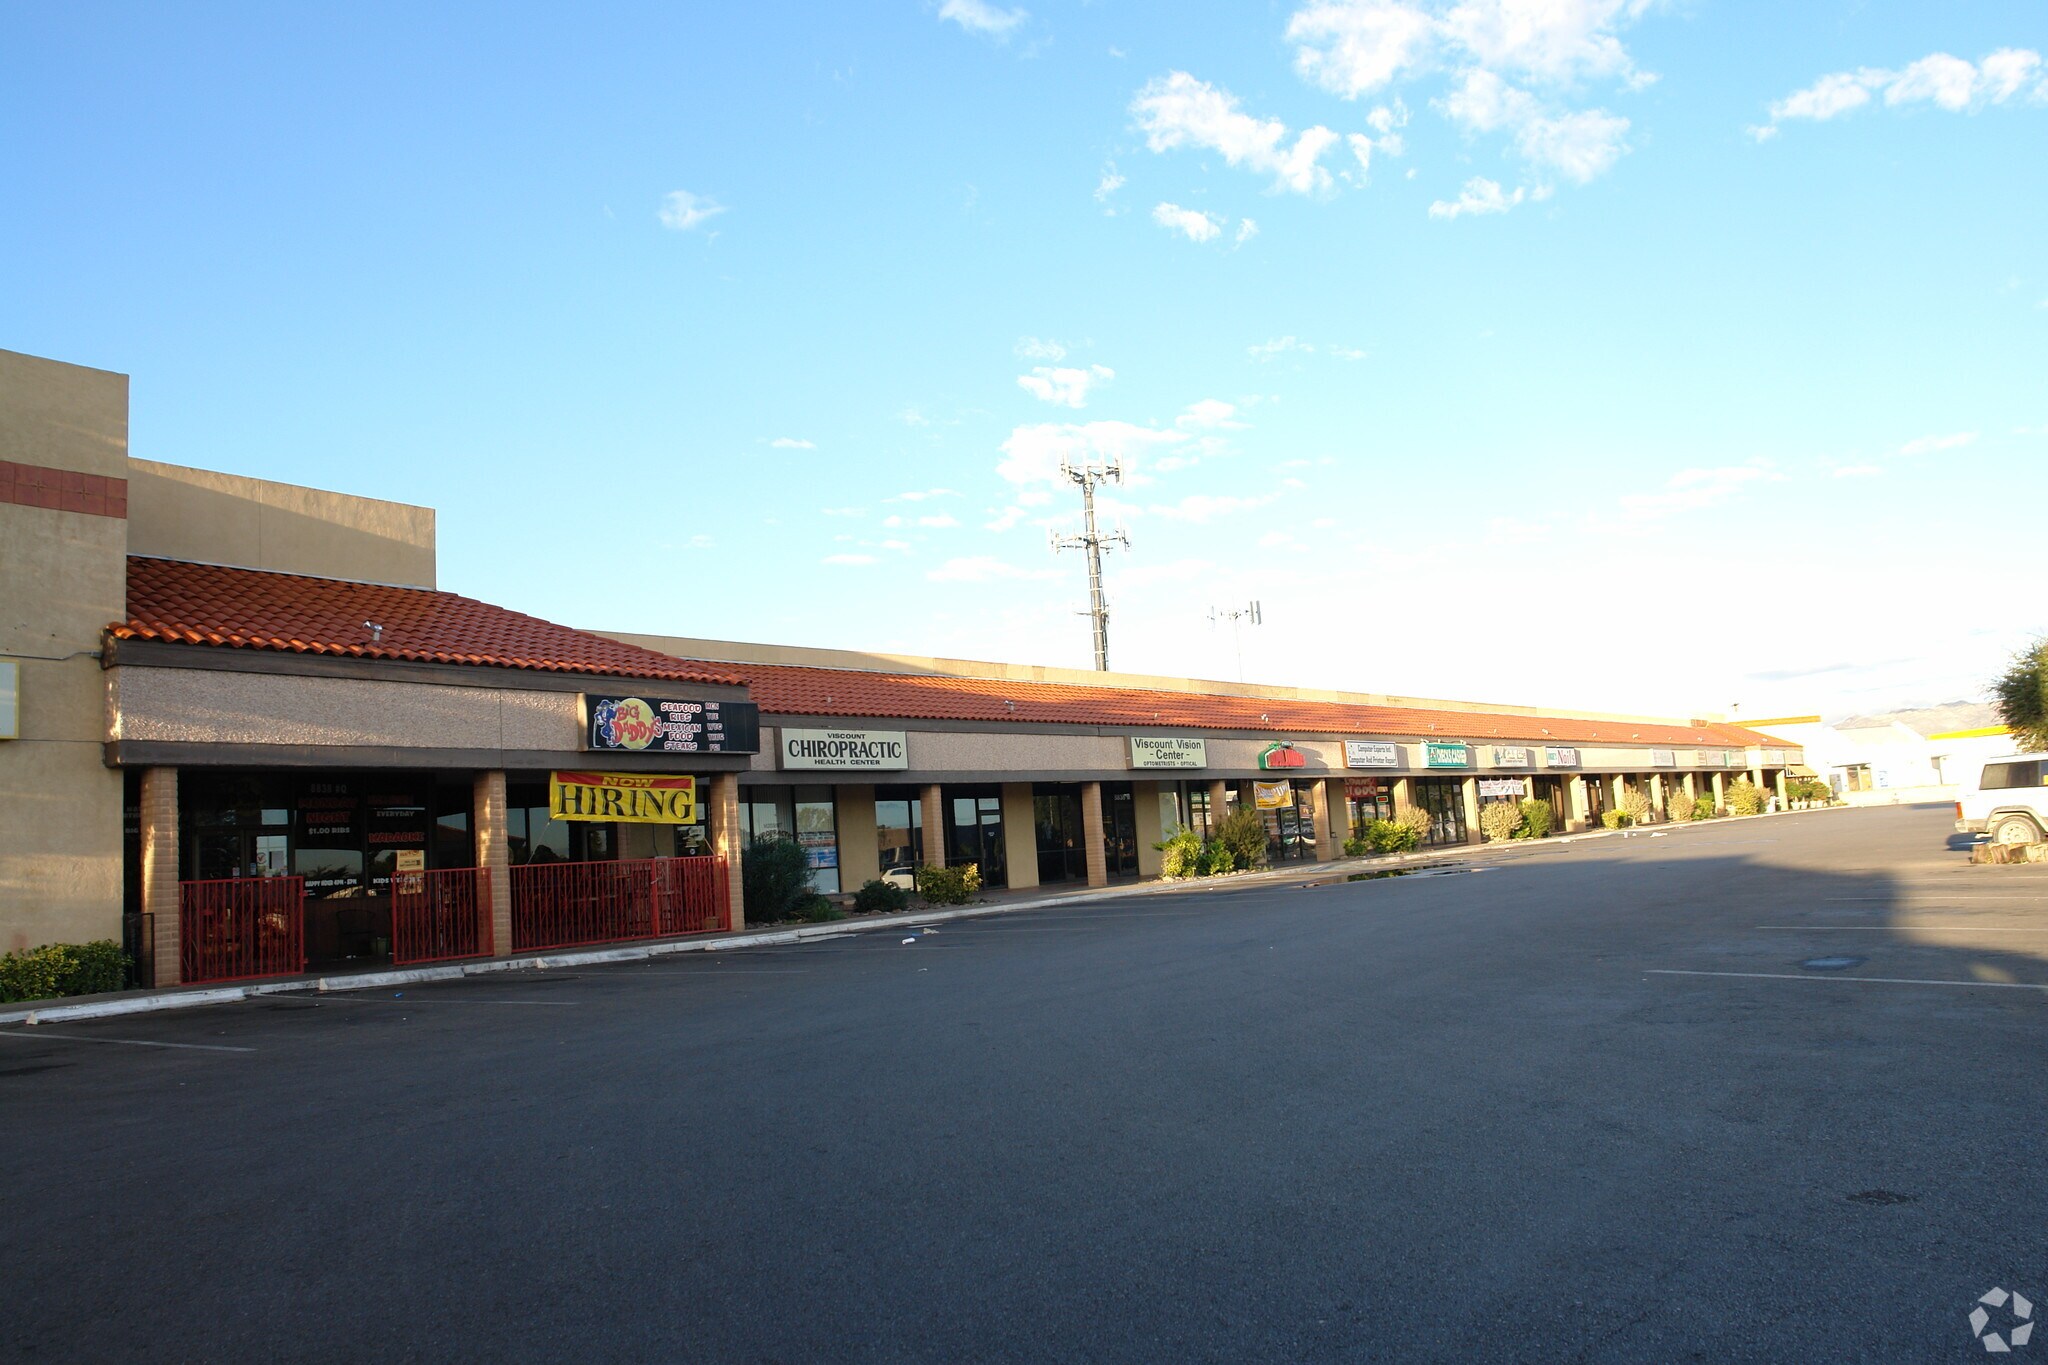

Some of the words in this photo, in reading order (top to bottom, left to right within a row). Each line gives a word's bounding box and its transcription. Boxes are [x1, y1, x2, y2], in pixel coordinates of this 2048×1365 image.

[660, 702, 702, 713] SEAFOOD
[669, 712, 692, 722] RIBS
[663, 722, 702, 733] MEXICAN
[669, 731, 693, 741] FOOD
[664, 741, 697, 751] STEAKS
[788, 739, 902, 759] CHIROPRACTIC
[1134, 738, 1173, 749] Viscount
[1176, 739, 1201, 750] Vision
[1156, 749, 1184, 760] Center
[1557, 749, 1576, 764] Nails
[602, 776, 655, 787] NOW
[556, 784, 693, 820] HIRING
[305, 811, 351, 823] NIGHT
[308, 827, 330, 835] $1.00
[368, 831, 424, 843] KARAOKE
